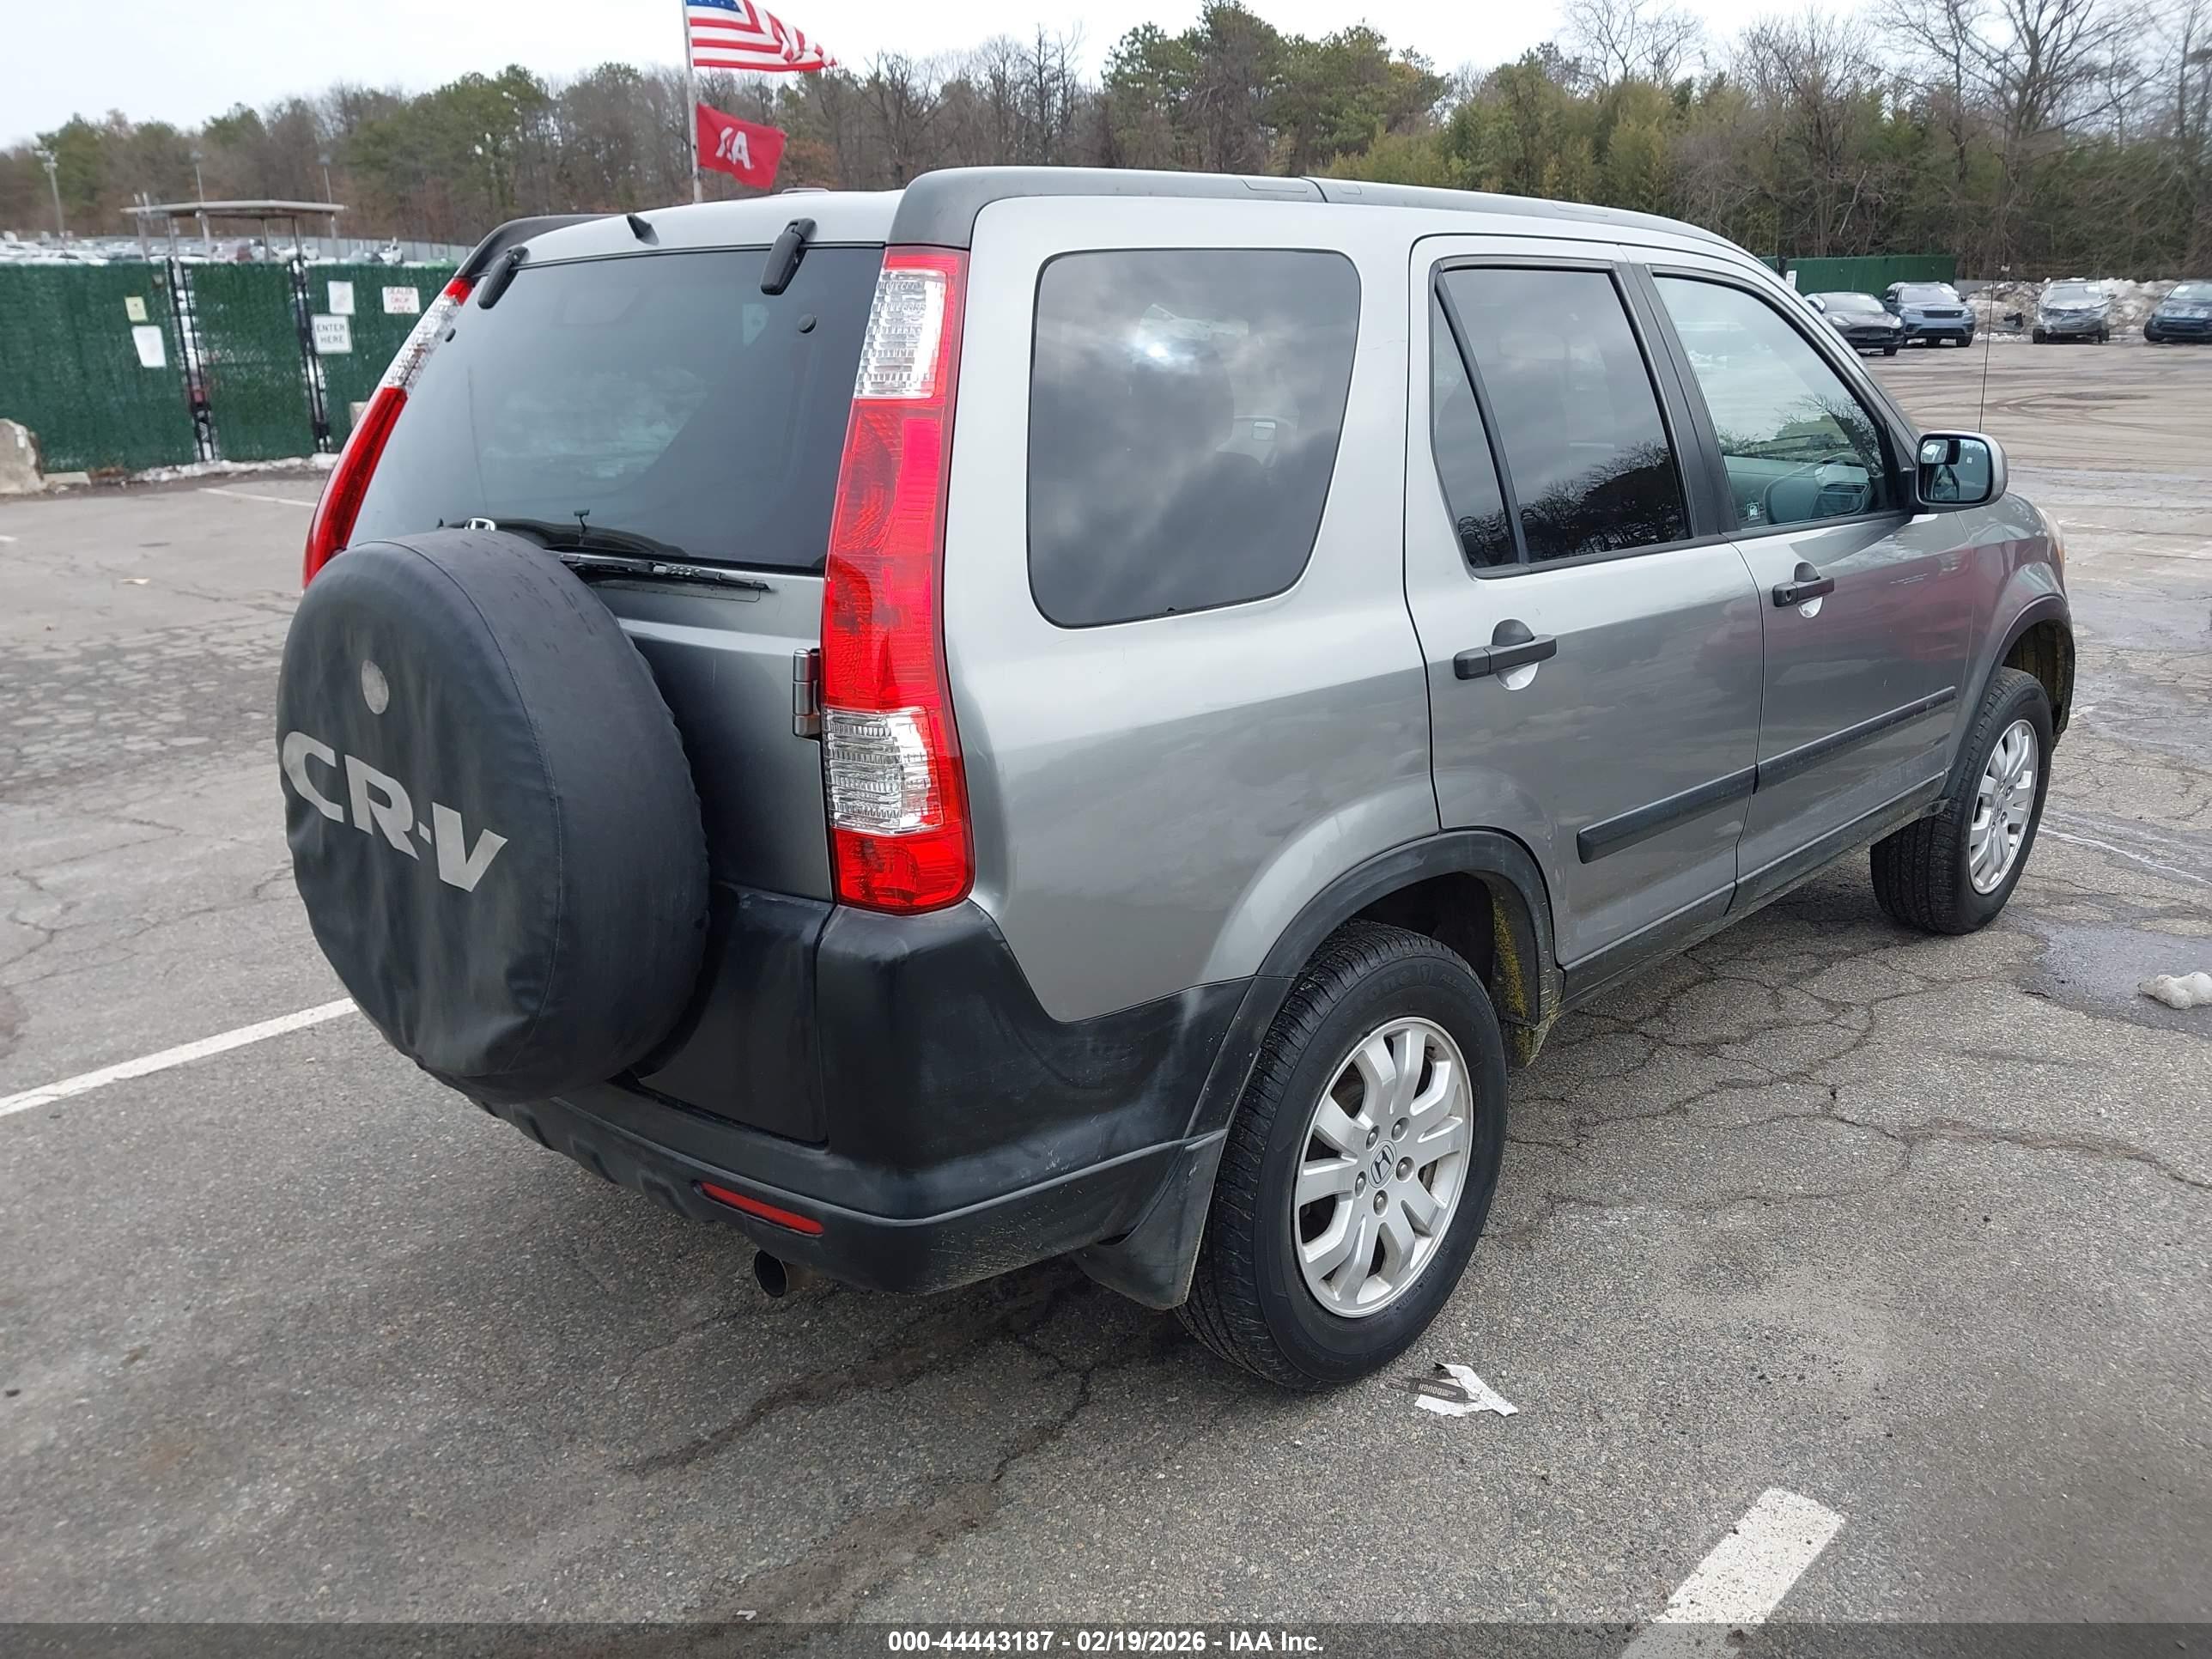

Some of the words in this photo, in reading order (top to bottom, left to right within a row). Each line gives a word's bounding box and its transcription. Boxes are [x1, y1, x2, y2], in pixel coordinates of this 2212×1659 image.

[316, 323, 345, 332] ENTER
[320, 336, 344, 344] HERE
[283, 731, 508, 893] CR-V
[1418, 1382, 1443, 1395] DOUGH
